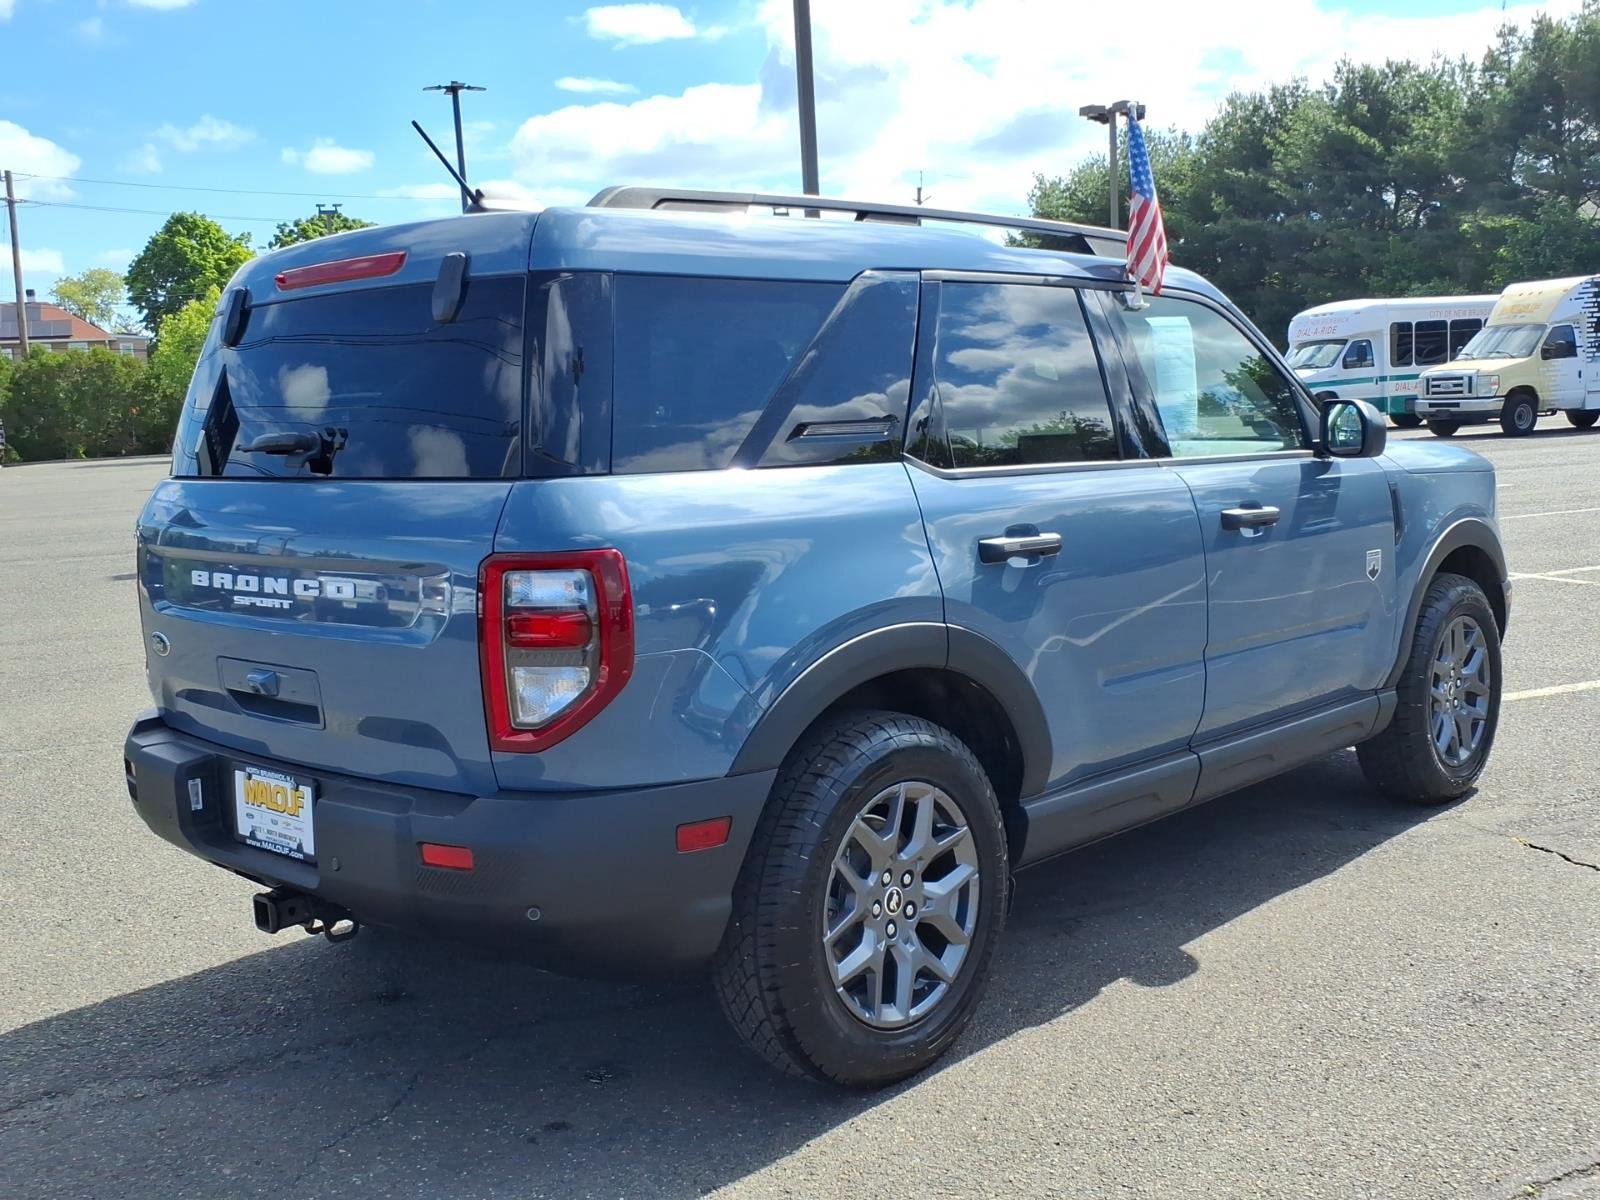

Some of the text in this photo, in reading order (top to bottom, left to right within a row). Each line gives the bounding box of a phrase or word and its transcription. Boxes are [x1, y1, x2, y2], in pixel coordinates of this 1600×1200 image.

[1296, 325, 1337, 338] DIAL-A-RIDE
[191, 570, 356, 599] BRONCO
[233, 596, 294, 609] SPORT
[244, 780, 305, 818] MALOUF
[246, 839, 304, 860] www.MALOUF.com
